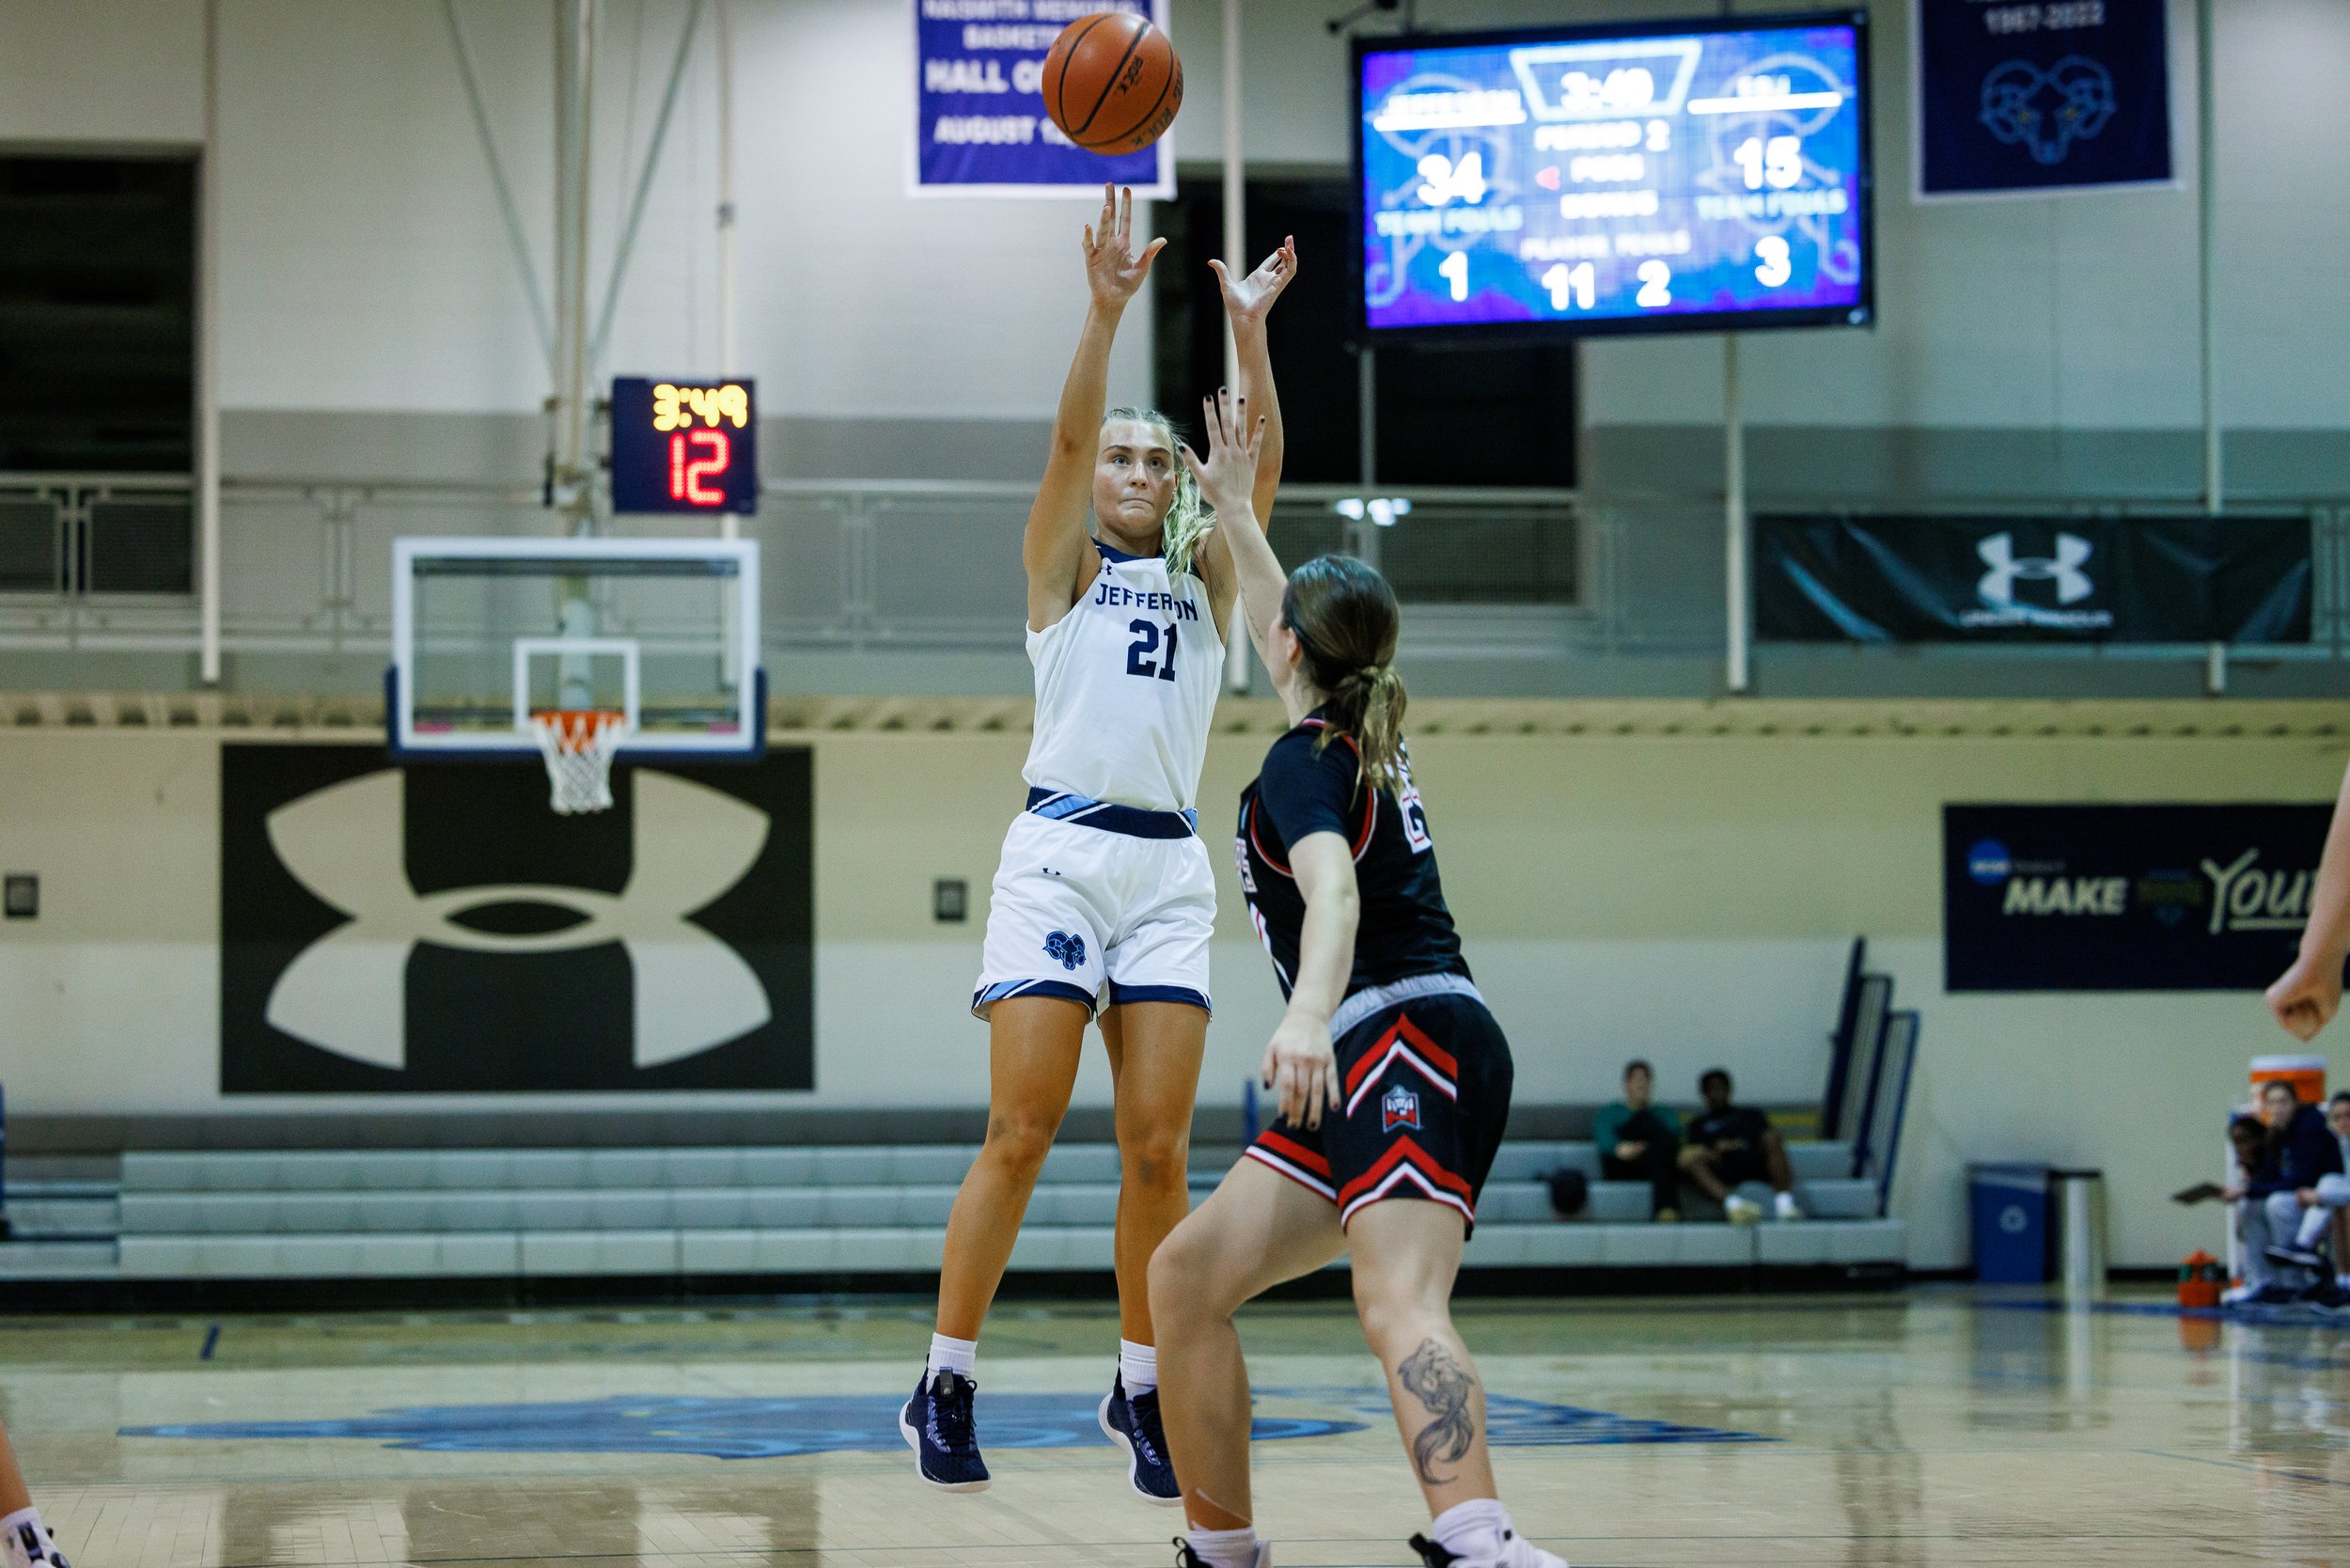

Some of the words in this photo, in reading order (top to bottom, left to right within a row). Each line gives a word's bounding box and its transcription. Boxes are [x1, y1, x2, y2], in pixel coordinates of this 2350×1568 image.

[925, 59, 1010, 93] HALL
[933, 116, 1036, 145] AUGUST
[1418, 151, 1485, 206] 34
[1733, 135, 1802, 189] 15
[1439, 250, 1468, 303] 1
[1541, 260, 1595, 310] 11
[1636, 259, 1671, 306] 2
[1754, 235, 1792, 287] 3
[653, 384, 747, 431] 3:49
[668, 429, 730, 506] 12
[1126, 619, 1177, 682] 21
[2003, 876, 2128, 916] MAKE
